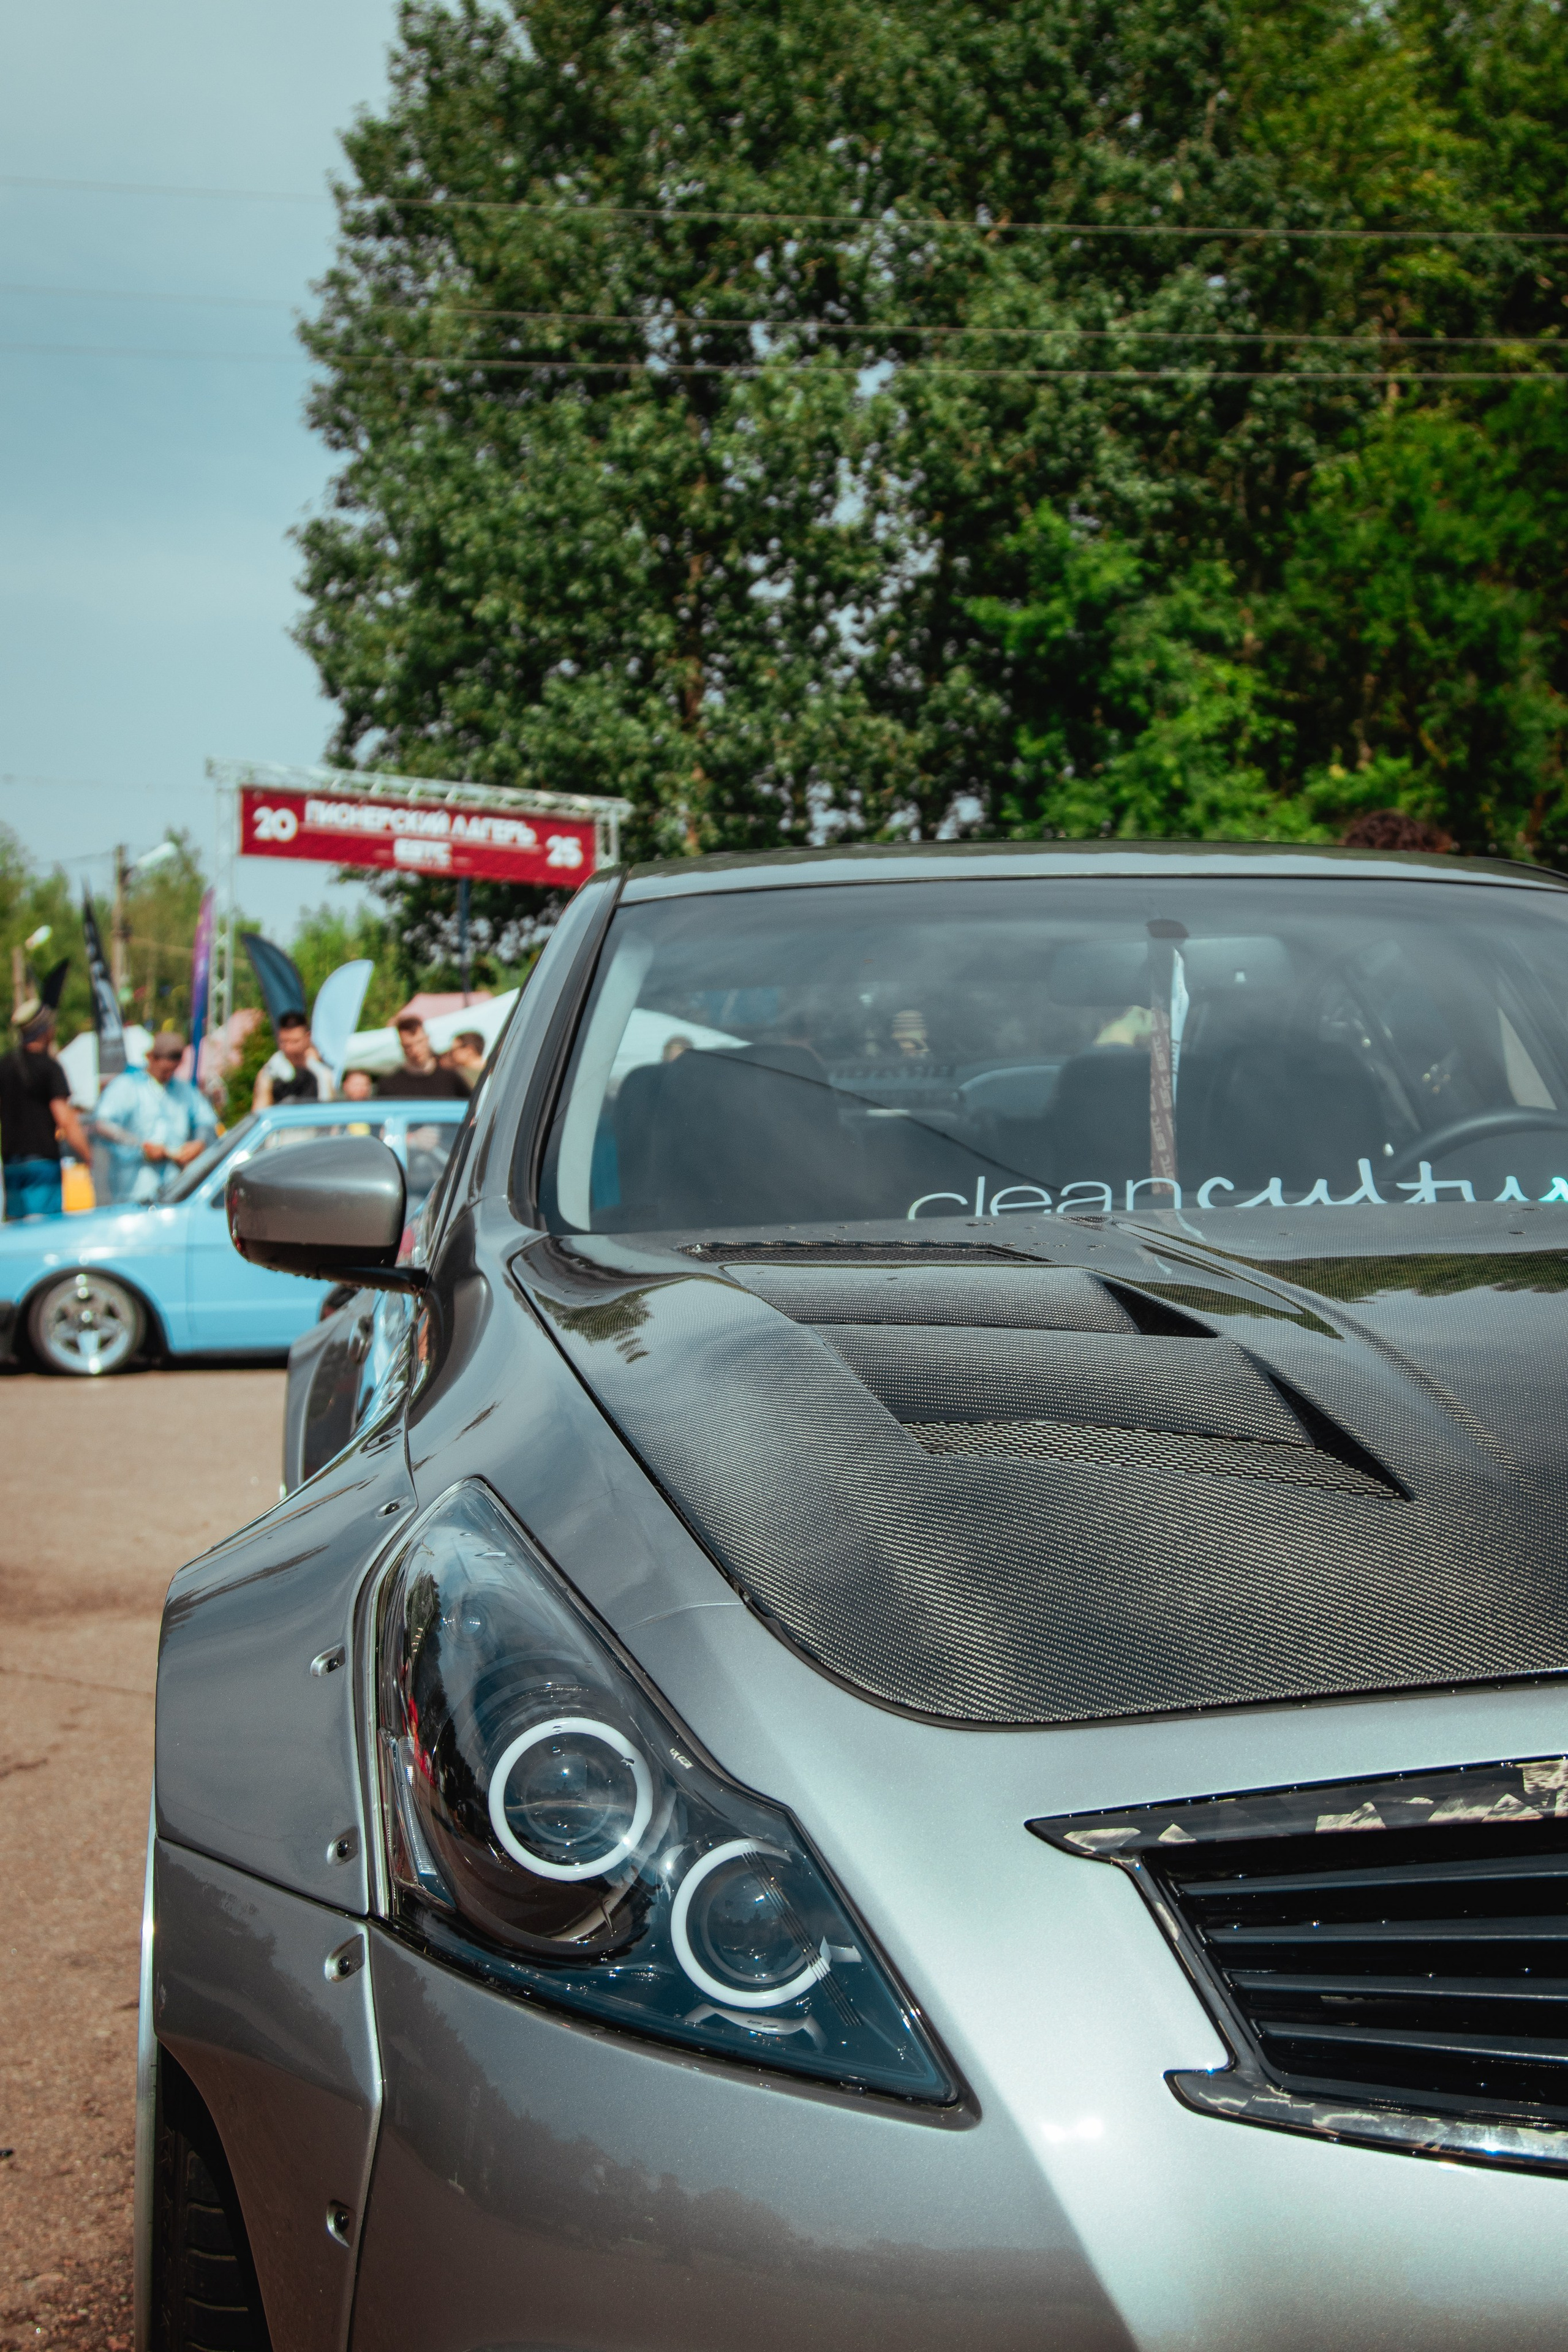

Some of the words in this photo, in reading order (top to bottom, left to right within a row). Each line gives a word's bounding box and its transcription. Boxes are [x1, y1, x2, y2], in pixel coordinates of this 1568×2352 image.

[252, 806, 298, 842] 20
[305, 799, 450, 834] ПИОНЕРСКИЙ
[451, 815, 537, 846] ЛАГЕРЬ
[546, 835, 583, 869] 25
